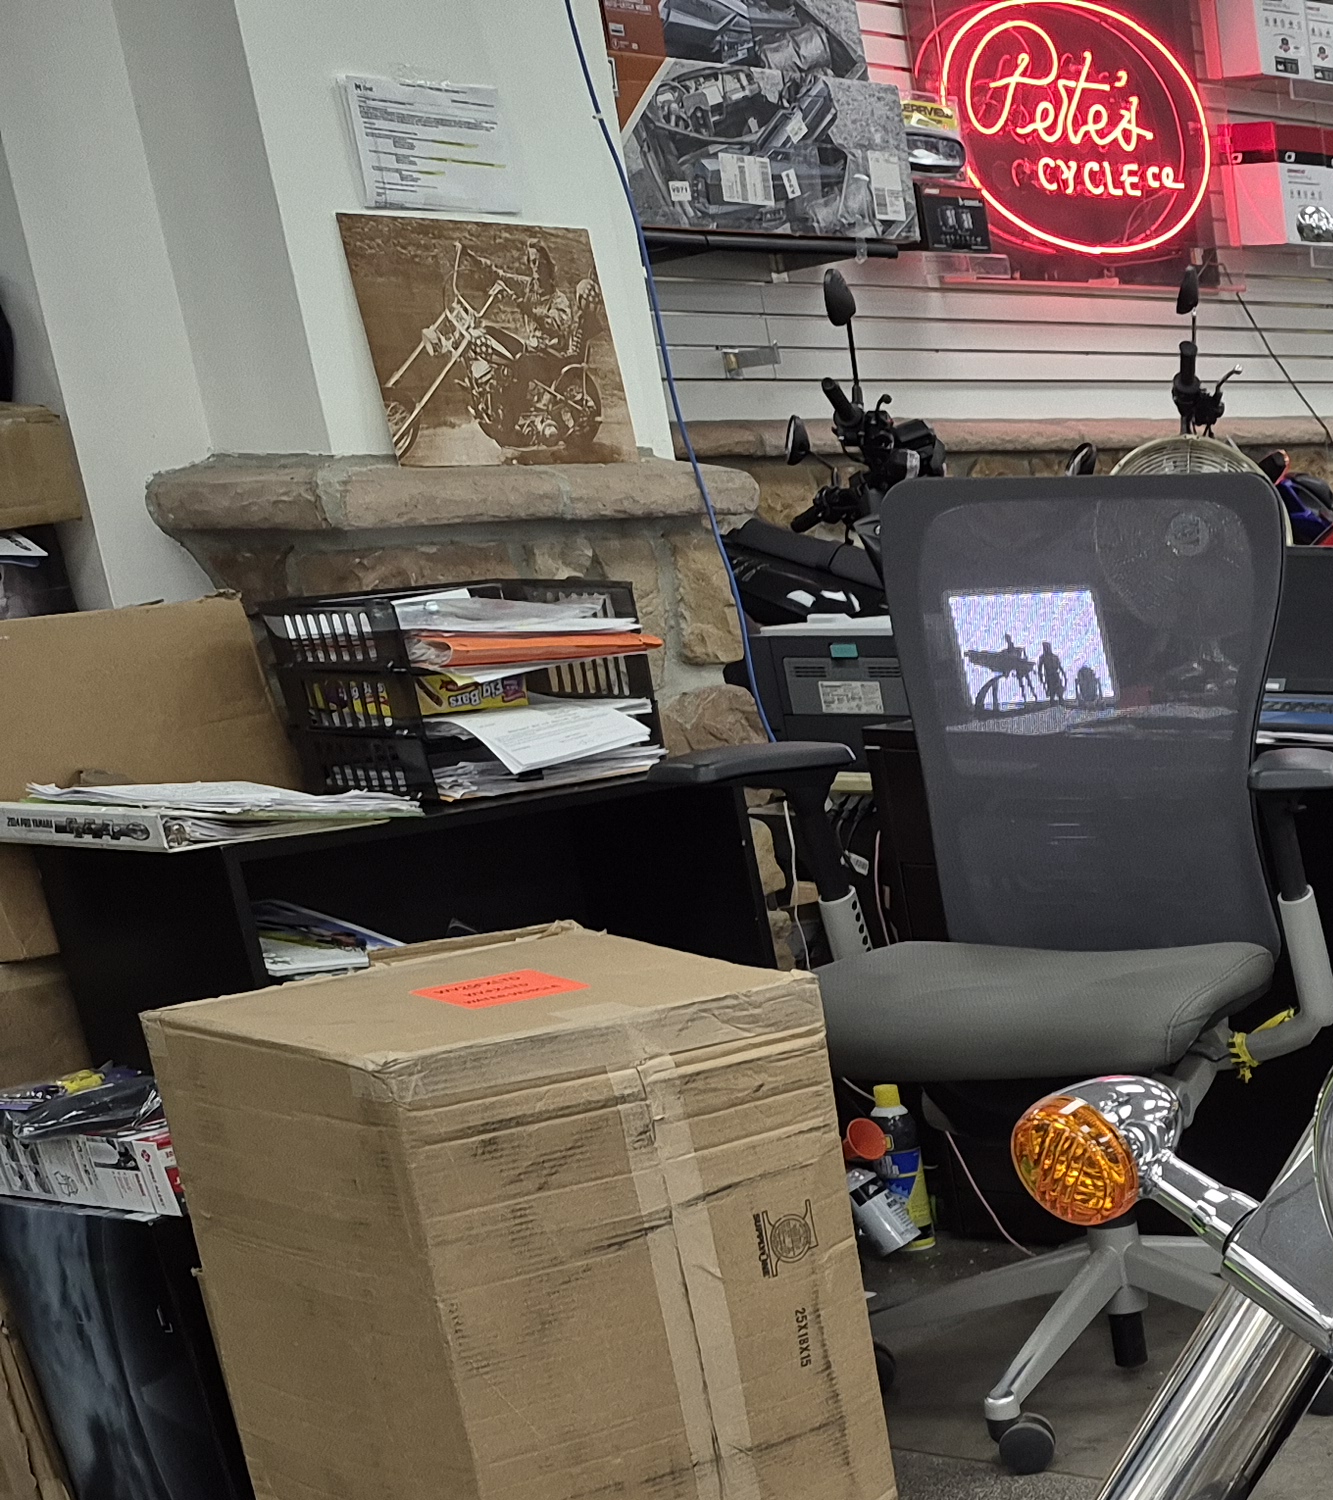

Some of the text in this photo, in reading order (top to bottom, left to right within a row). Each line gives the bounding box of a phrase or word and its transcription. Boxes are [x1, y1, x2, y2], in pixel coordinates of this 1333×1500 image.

[966, 20, 1153, 151] Pete's
[1037, 156, 1142, 197] CYCLE
[448, 690, 481, 708] Bars
[482, 679, 504, 699] Fig
[32, 818, 54, 829] YAMAHA
[795, 1307, 812, 1368] 25X18X15
